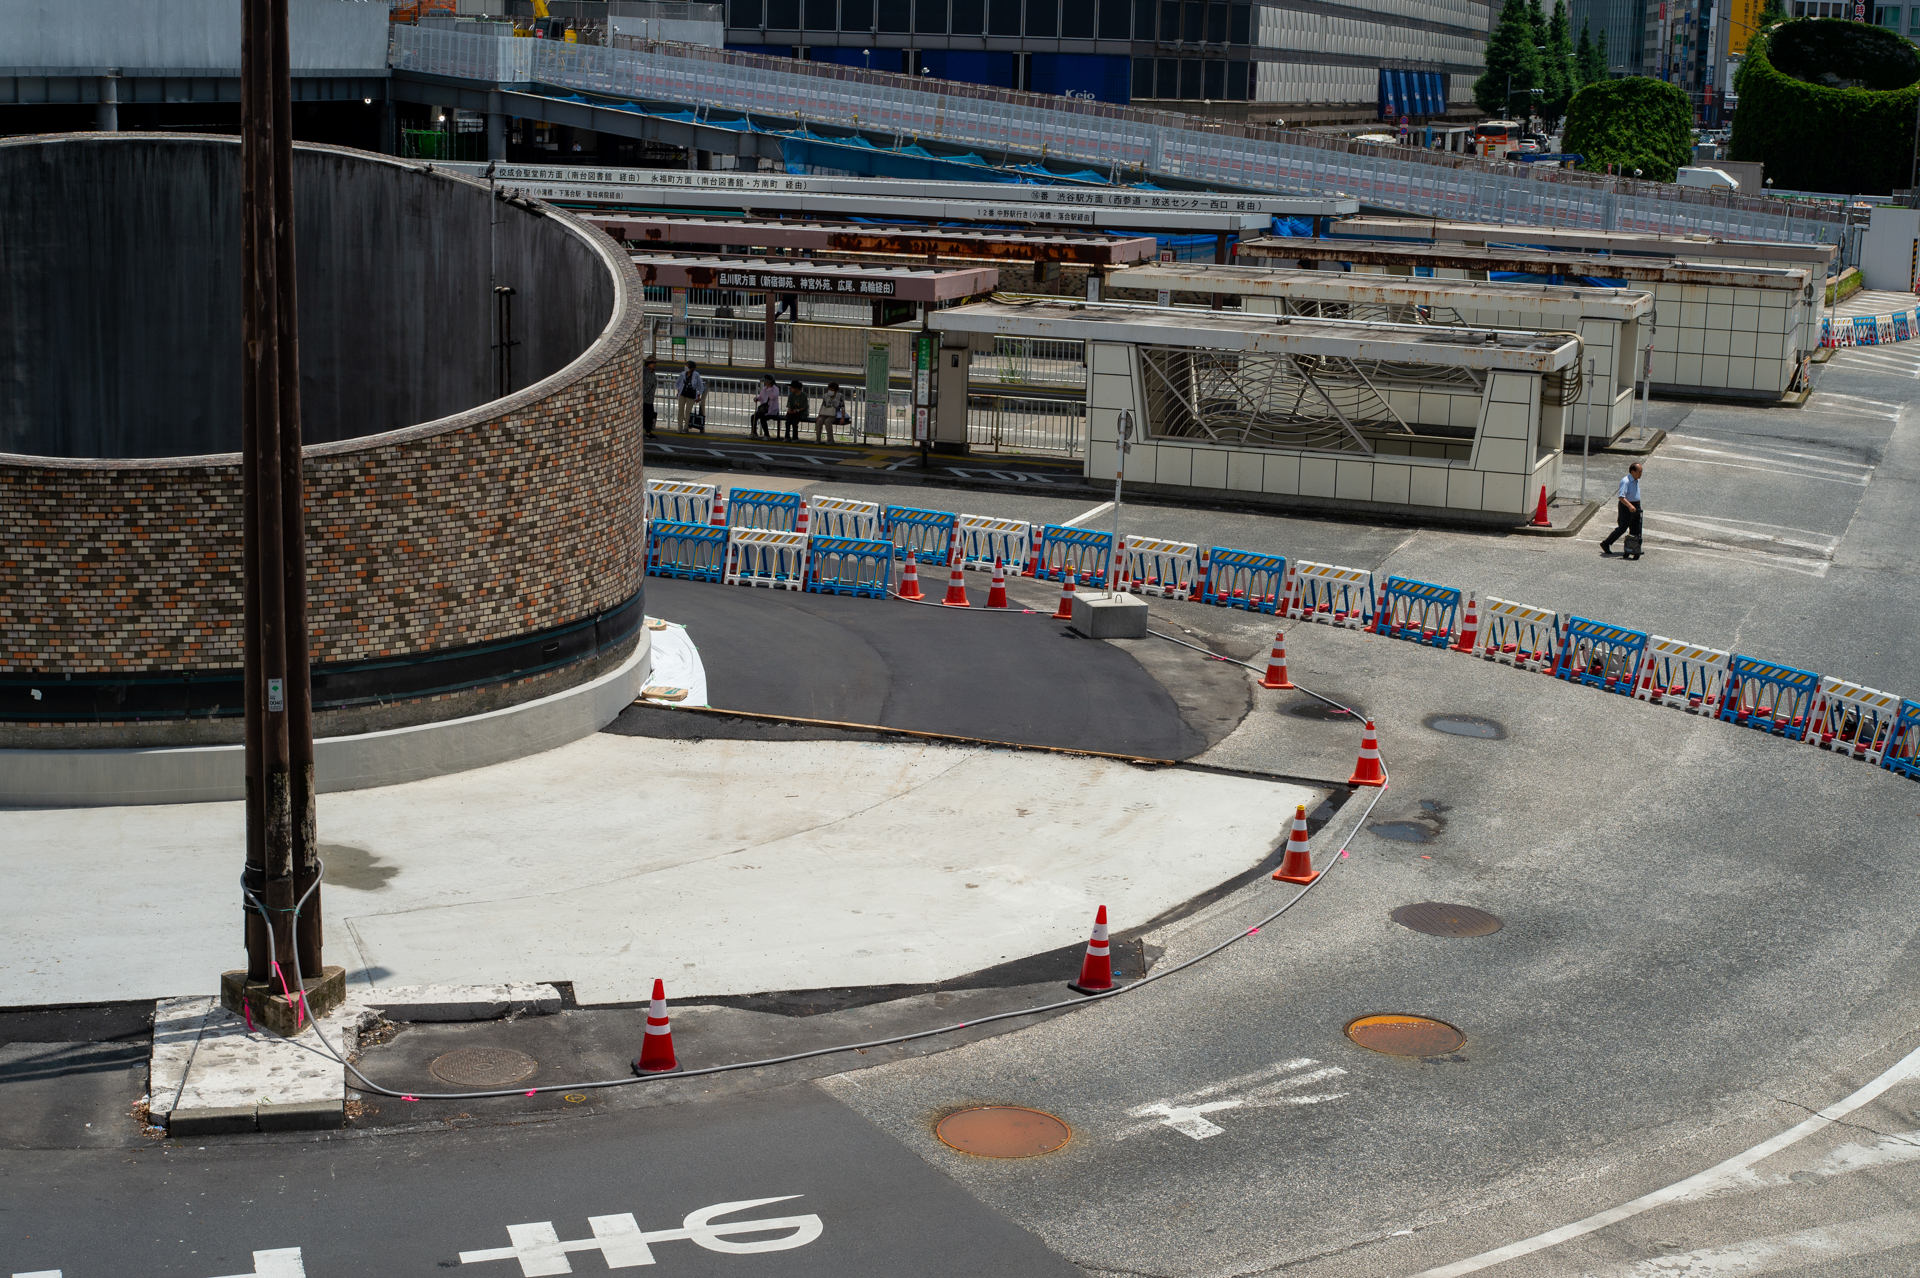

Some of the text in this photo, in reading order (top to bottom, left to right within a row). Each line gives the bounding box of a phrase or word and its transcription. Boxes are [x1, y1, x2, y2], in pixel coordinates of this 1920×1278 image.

[1065, 89, 1096, 100] Keio
[1056, 191, 1228, 209] 渋谷駅方面（西参道・放送センター西口
